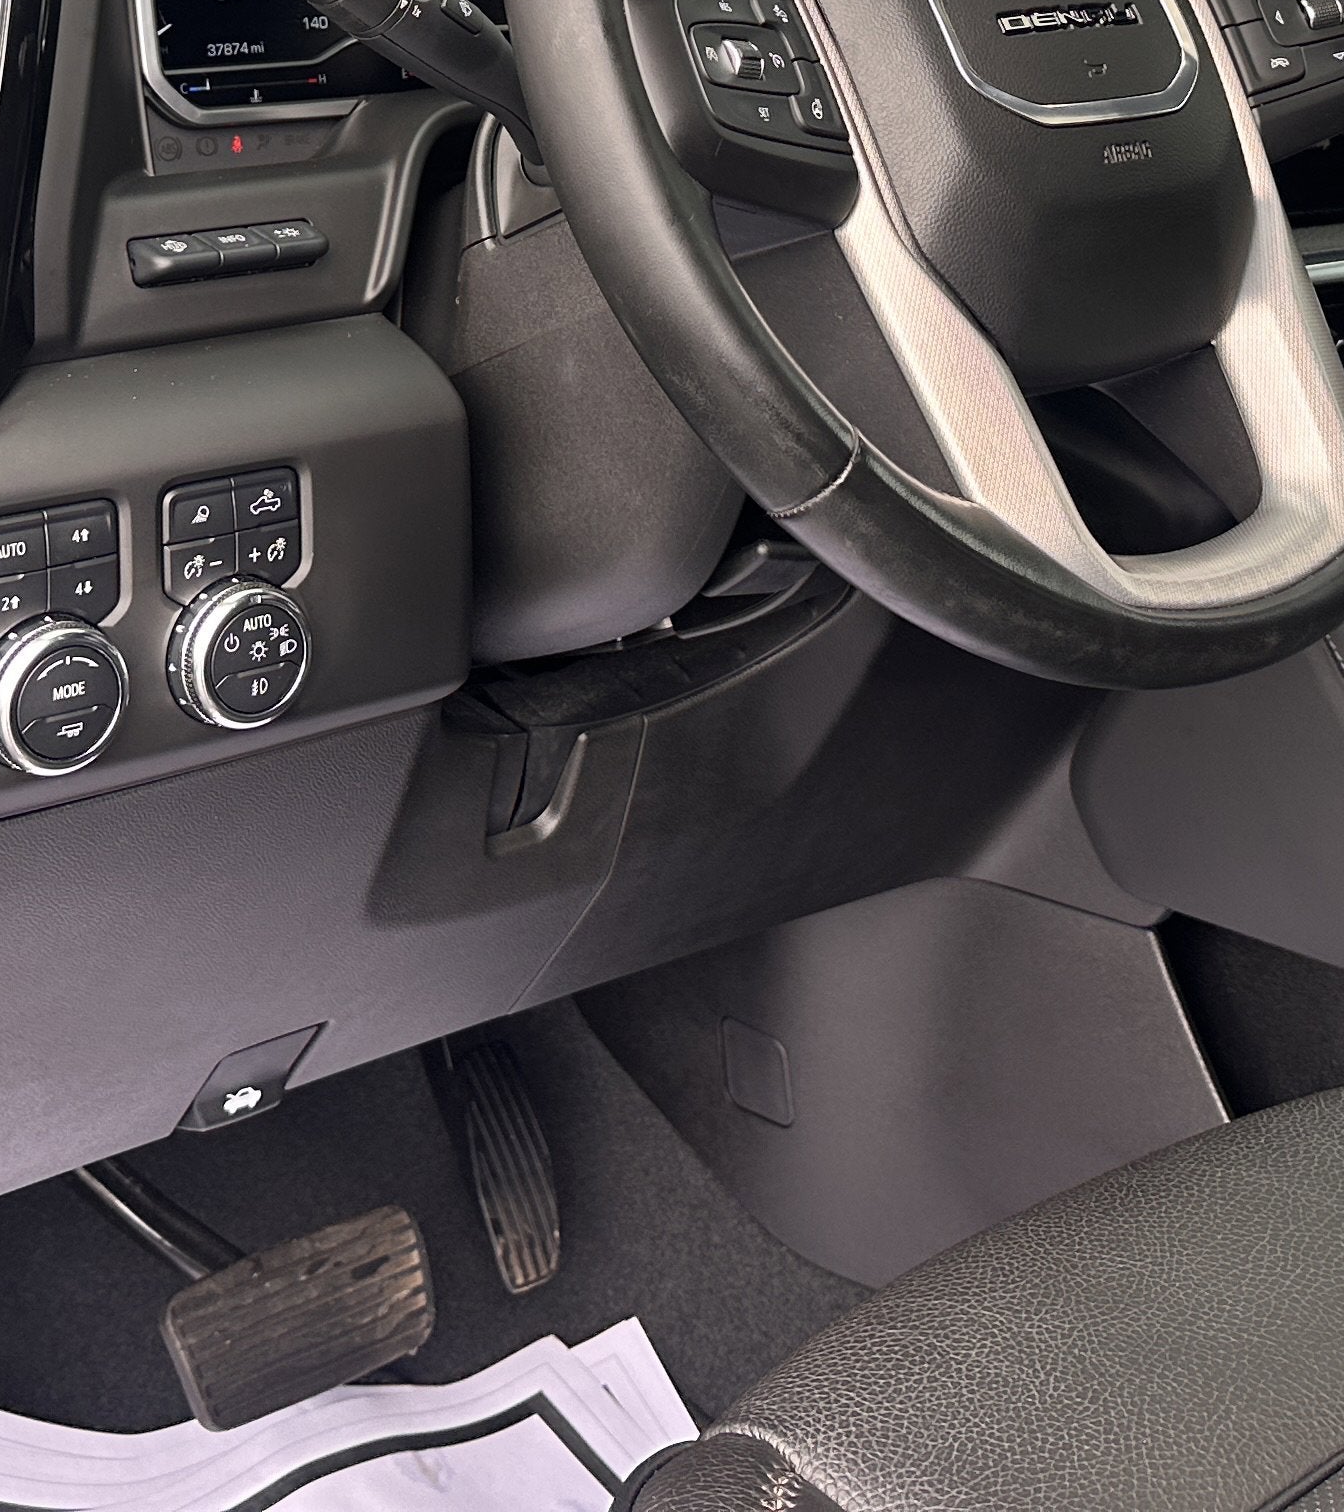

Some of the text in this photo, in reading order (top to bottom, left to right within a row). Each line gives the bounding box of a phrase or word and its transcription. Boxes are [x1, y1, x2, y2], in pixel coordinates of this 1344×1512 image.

[302, 16, 328, 30] 140
[207, 42, 249, 57] 37874
[1103, 139, 1153, 164] AIRBAG
[242, 613, 272, 633] AUTO
[52, 680, 86, 702] MODE
